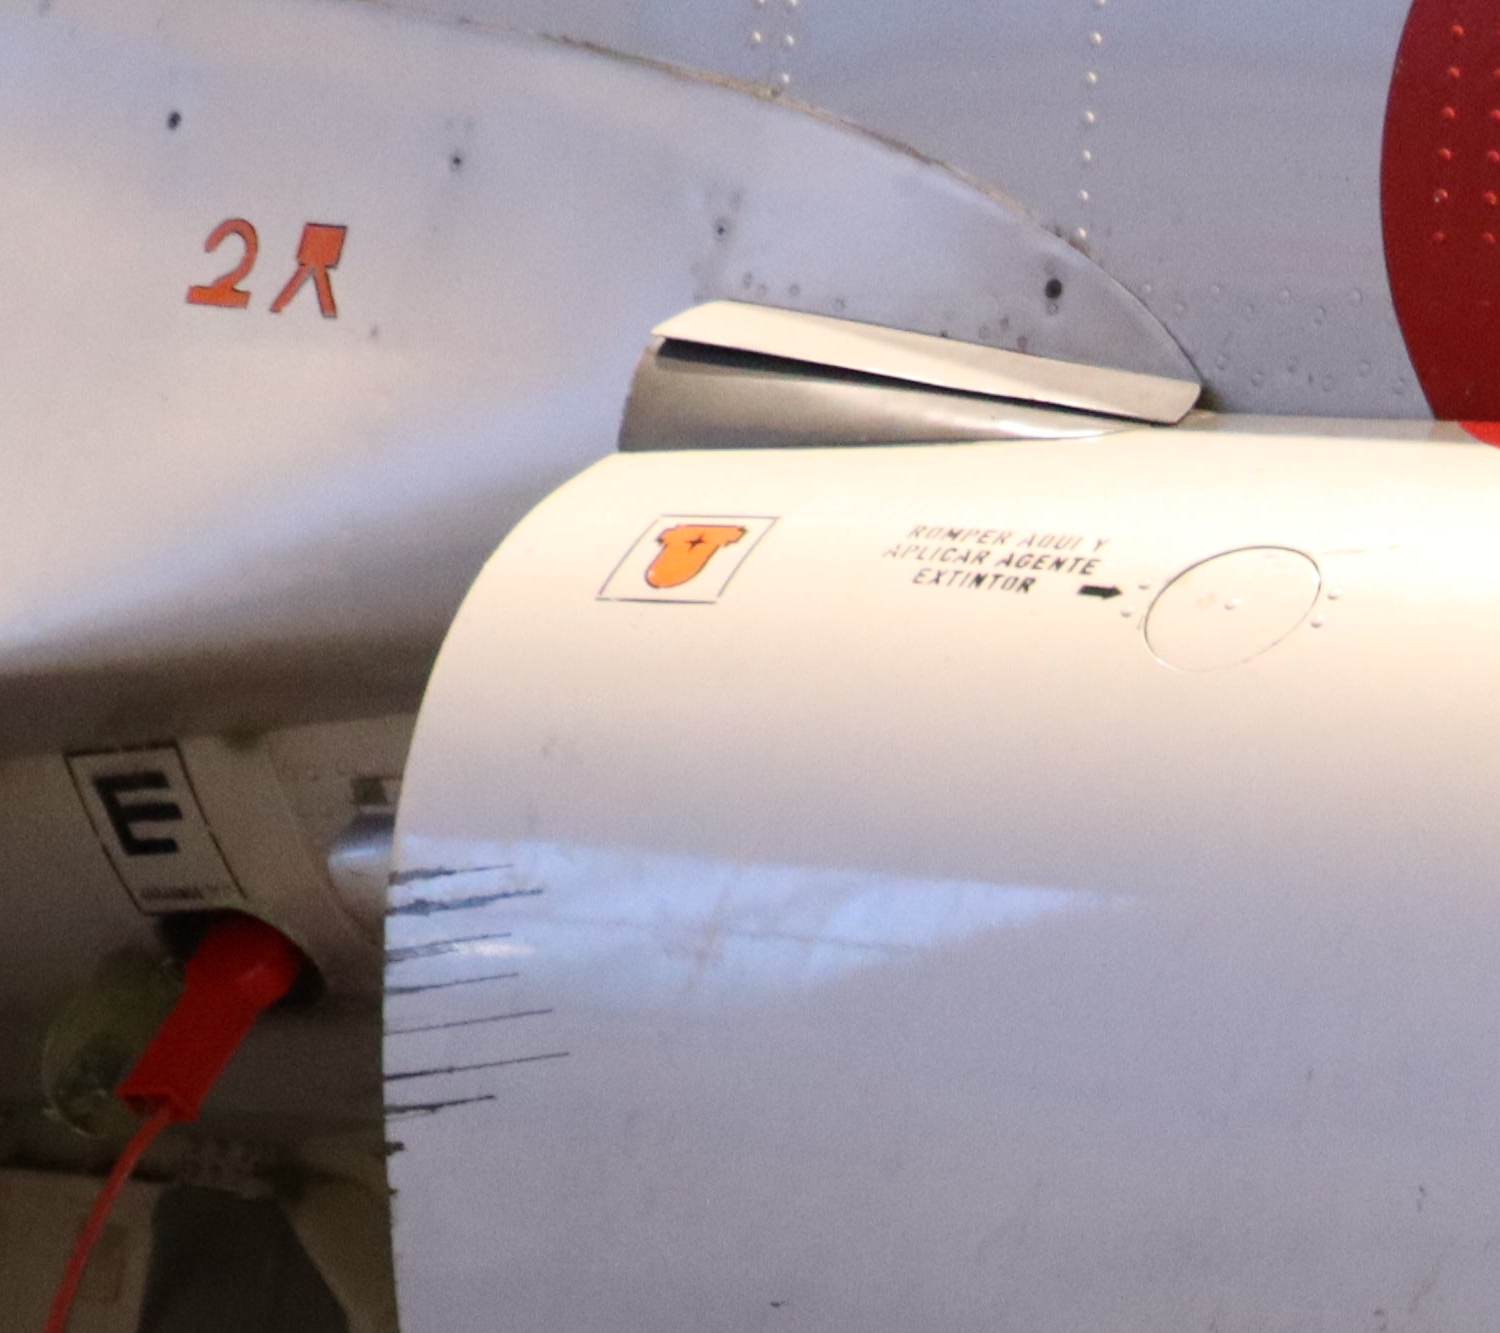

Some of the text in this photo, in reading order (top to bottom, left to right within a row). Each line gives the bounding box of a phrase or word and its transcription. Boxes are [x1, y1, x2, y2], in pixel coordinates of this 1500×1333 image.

[907, 524, 1014, 547] ROMPER
[1093, 538, 1109, 552] Y
[882, 543, 1102, 577] APLICAR AGENTE
[912, 568, 1037, 594] EXTINTOR
